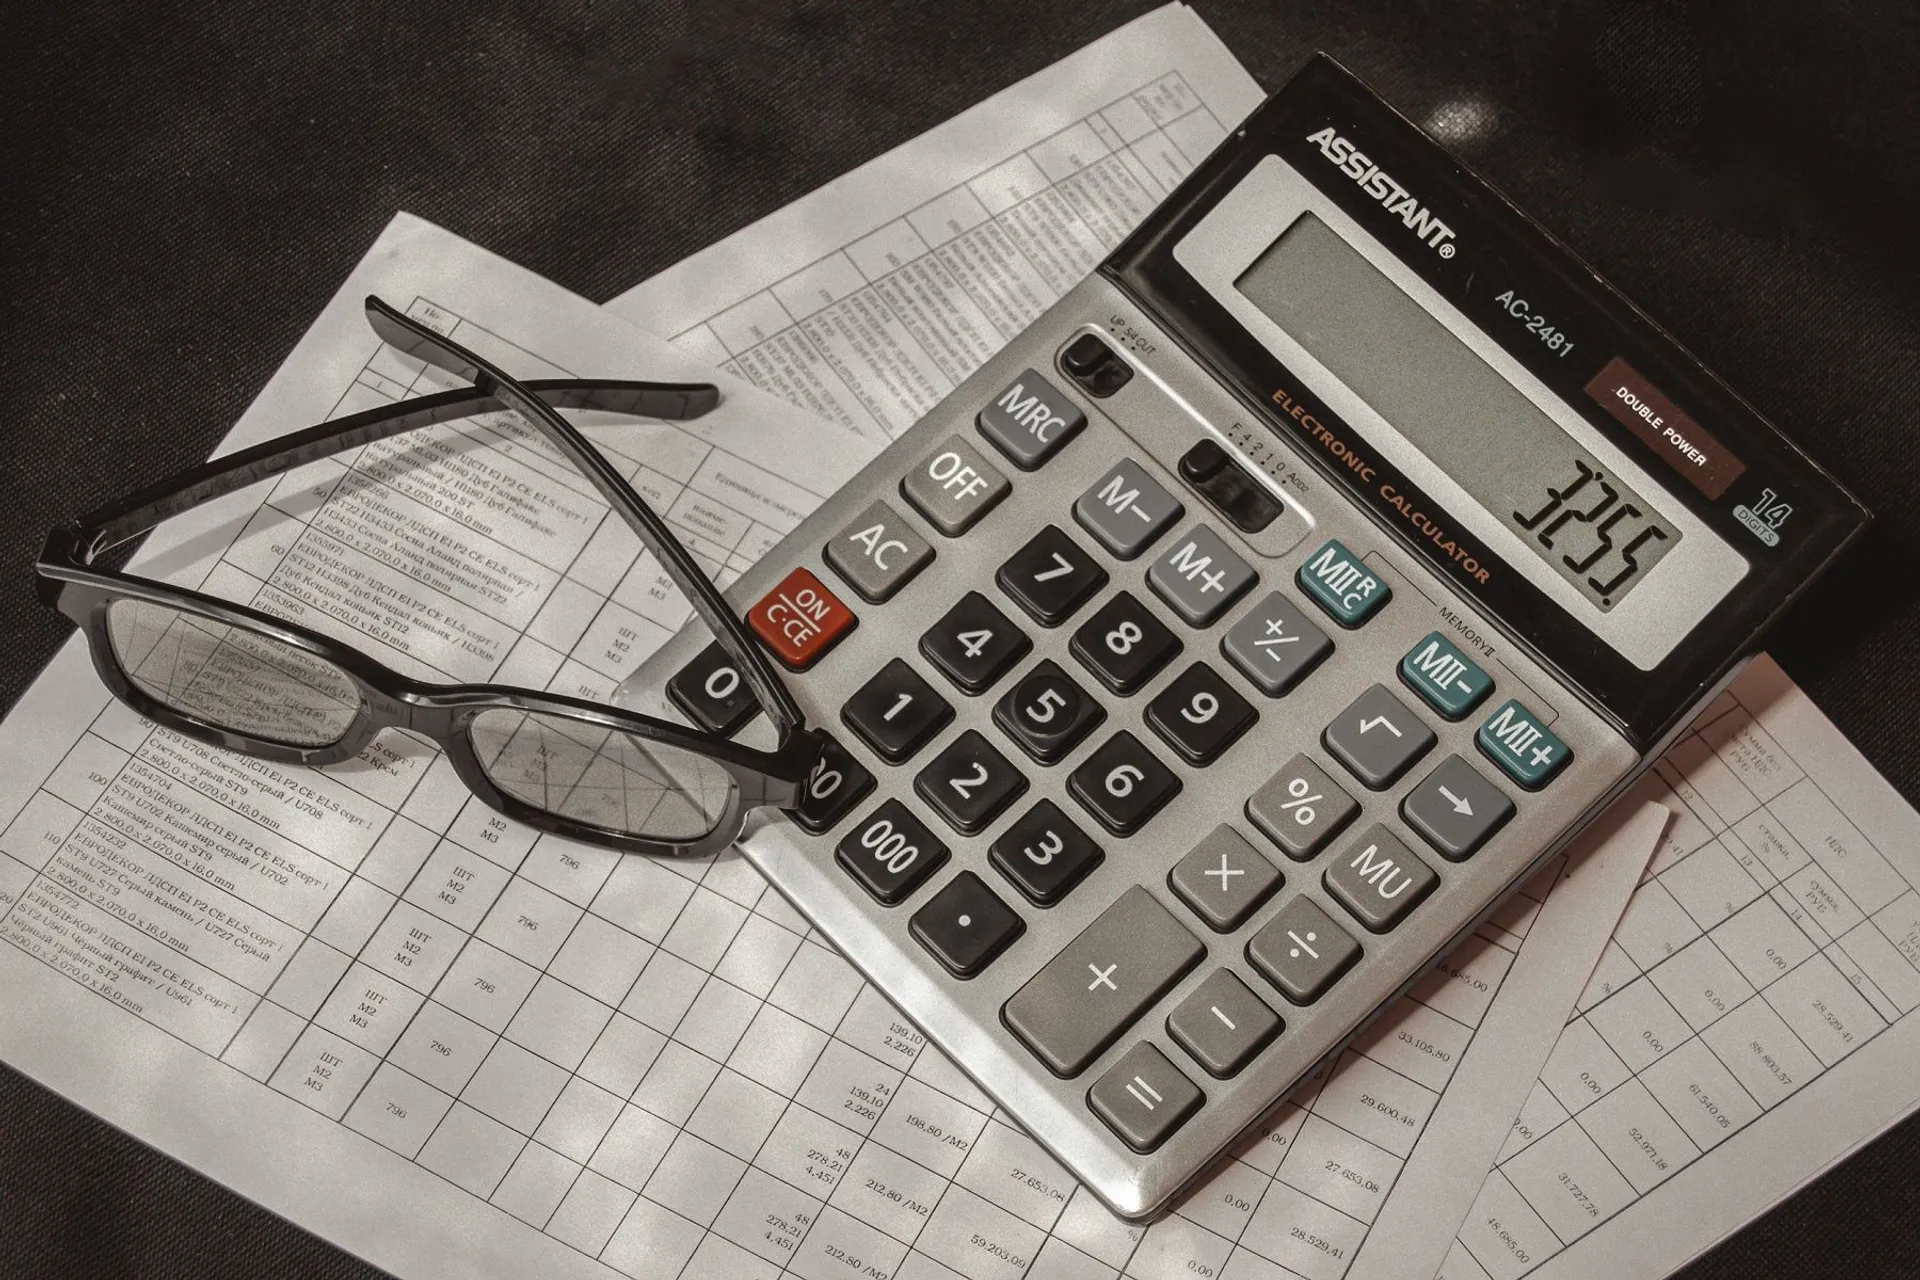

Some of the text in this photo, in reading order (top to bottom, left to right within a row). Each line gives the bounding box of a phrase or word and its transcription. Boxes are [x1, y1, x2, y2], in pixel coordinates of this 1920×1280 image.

[1110, 314, 1125, 326] UP
[1136, 338, 1156, 355] CUT
[1495, 290, 1575, 358] AC-2481
[997, 384, 1066, 443] MRC
[1615, 385, 1708, 468] DOUBLE POWER
[1253, 442, 1263, 451] 2
[929, 450, 987, 502] OFF
[1272, 389, 1491, 585] ELECTRONIC CALCULATOR
[312, 486, 328, 499] 50
[1752, 488, 1792, 529] 14
[1737, 508, 1775, 544] DIGITS
[270, 544, 286, 556] 60
[849, 523, 908, 570] AC
[1034, 552, 1074, 582] 7
[1169, 541, 1226, 593] M+
[795, 588, 831, 621] ON
[382, 616, 410, 635] ST12
[1105, 621, 1143, 655] 8
[956, 629, 993, 658] 4
[705, 667, 740, 699] 0
[883, 693, 913, 721] 1
[1026, 688, 1066, 723] 5
[1180, 692, 1219, 724] 9
[88, 771, 109, 786] 100
[129, 761, 173, 791] 1354704
[949, 762, 989, 799] 2
[1105, 764, 1145, 797] 6
[1280, 778, 1323, 826] %
[43, 830, 61, 845] 110
[82, 820, 130, 850] 1354232
[101, 795, 213, 861] Кашемир серый ST9
[110, 784, 136, 801] ST9
[135, 796, 165, 819] U702
[163, 813, 216, 848] Кашемир
[215, 844, 251, 866] серый
[259, 865, 289, 886] U702
[120, 773, 191, 815] ЕВРОДЕКОР
[188, 812, 225, 836] ЛДСП
[237, 837, 254, 852] P2
[271, 855, 296, 873] ELS
[294, 870, 322, 887] сорт
[559, 853, 581, 870] 796
[860, 820, 919, 874] 000
[1024, 830, 1064, 865] 3
[1740, 854, 1754, 867] 13
[213, 875, 236, 892] mm
[452, 865, 476, 882] ШТ
[1350, 843, 1413, 900] MU
[35, 879, 81, 910] 1354772
[64, 843, 90, 862] ST9
[88, 856, 119, 877] U727
[117, 873, 154, 900] Серый
[153, 895, 194, 922] камень
[204, 921, 235, 941] U727
[233, 937, 271, 962] Серый
[95, 878, 121, 897] ST9
[517, 915, 539, 931] 796
[1790, 908, 1803, 925] 14
[408, 927, 432, 943] ШТ
[95, 964, 120, 983] ST2
[473, 977, 496, 994] 796
[874, 1083, 890, 1096] 24
[835, 1148, 851, 1160] 48
[794, 1213, 811, 1226] 48
